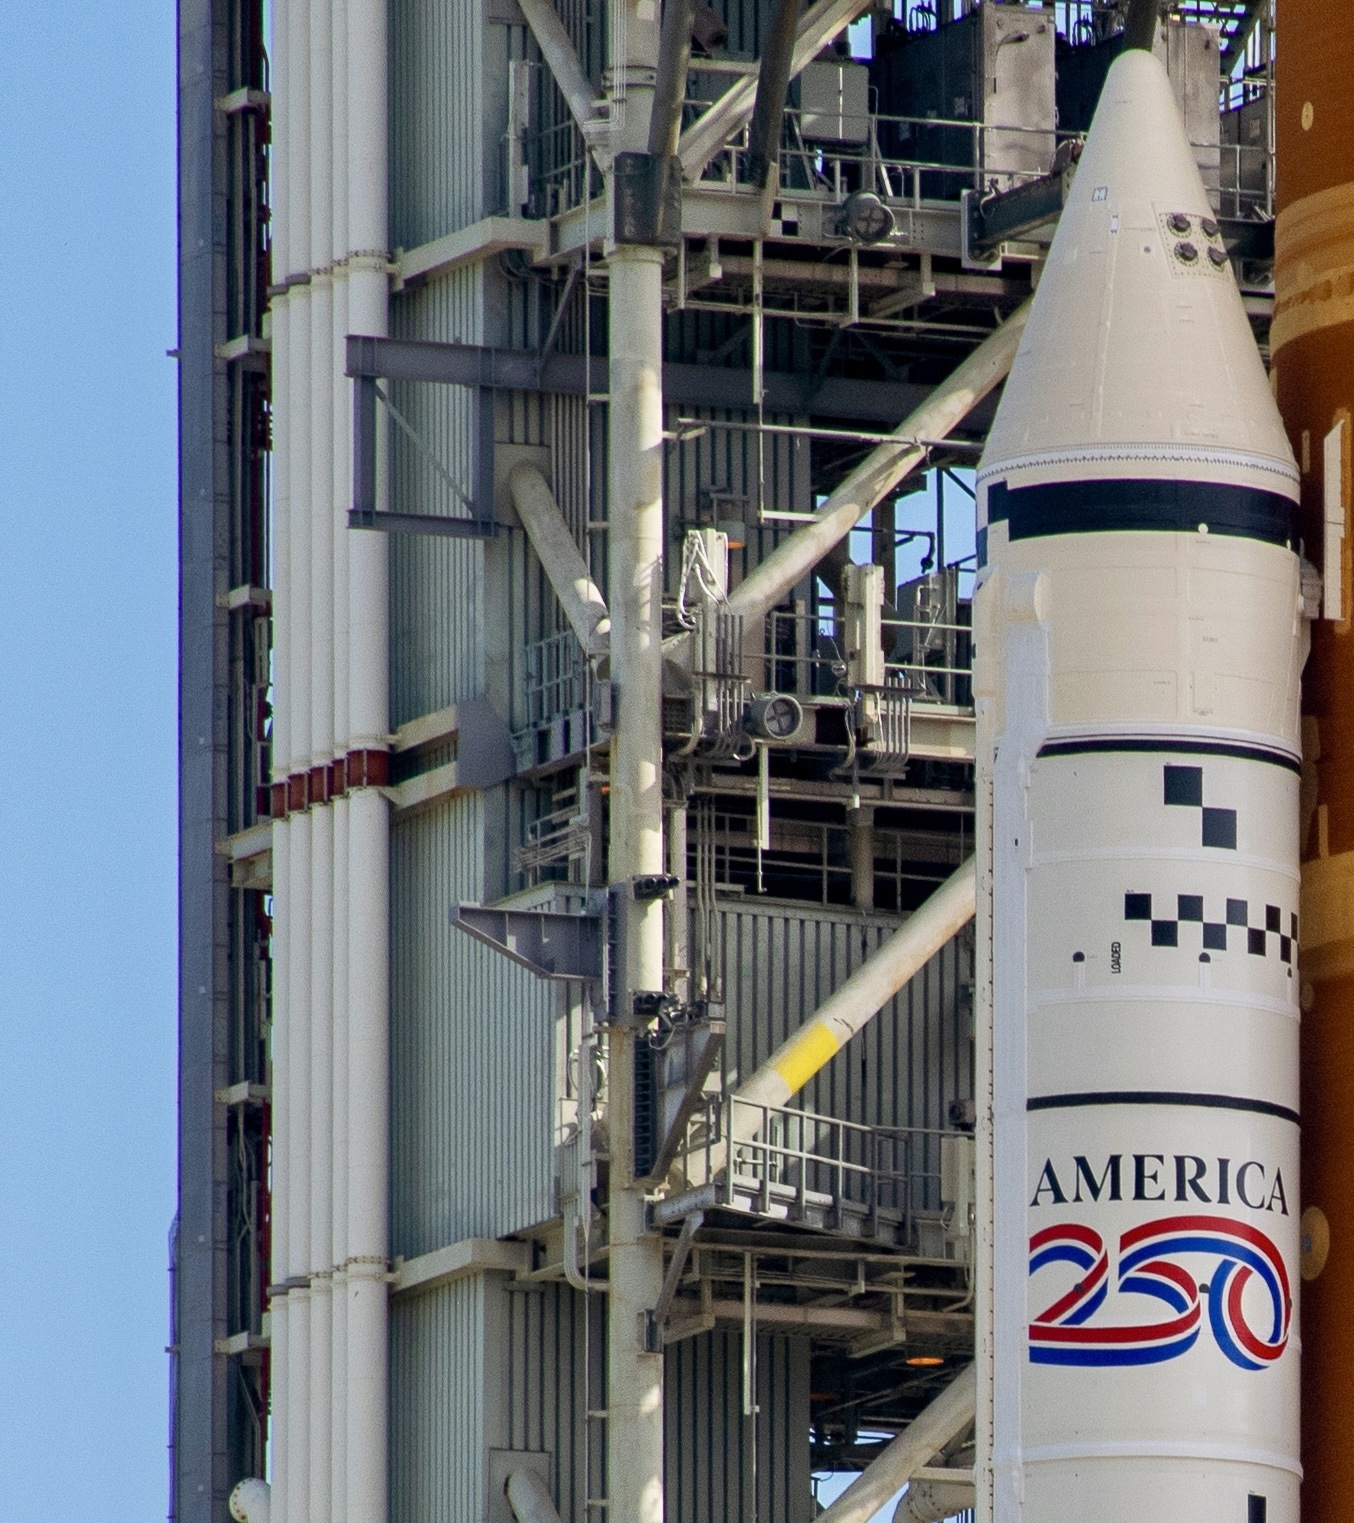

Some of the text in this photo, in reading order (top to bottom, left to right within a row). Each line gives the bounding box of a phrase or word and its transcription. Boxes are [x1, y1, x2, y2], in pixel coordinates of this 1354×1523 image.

[1111, 941, 1121, 974] LOADED
[1029, 1154, 1290, 1216] AMERICA
[1029, 1215, 1292, 1371] 250
